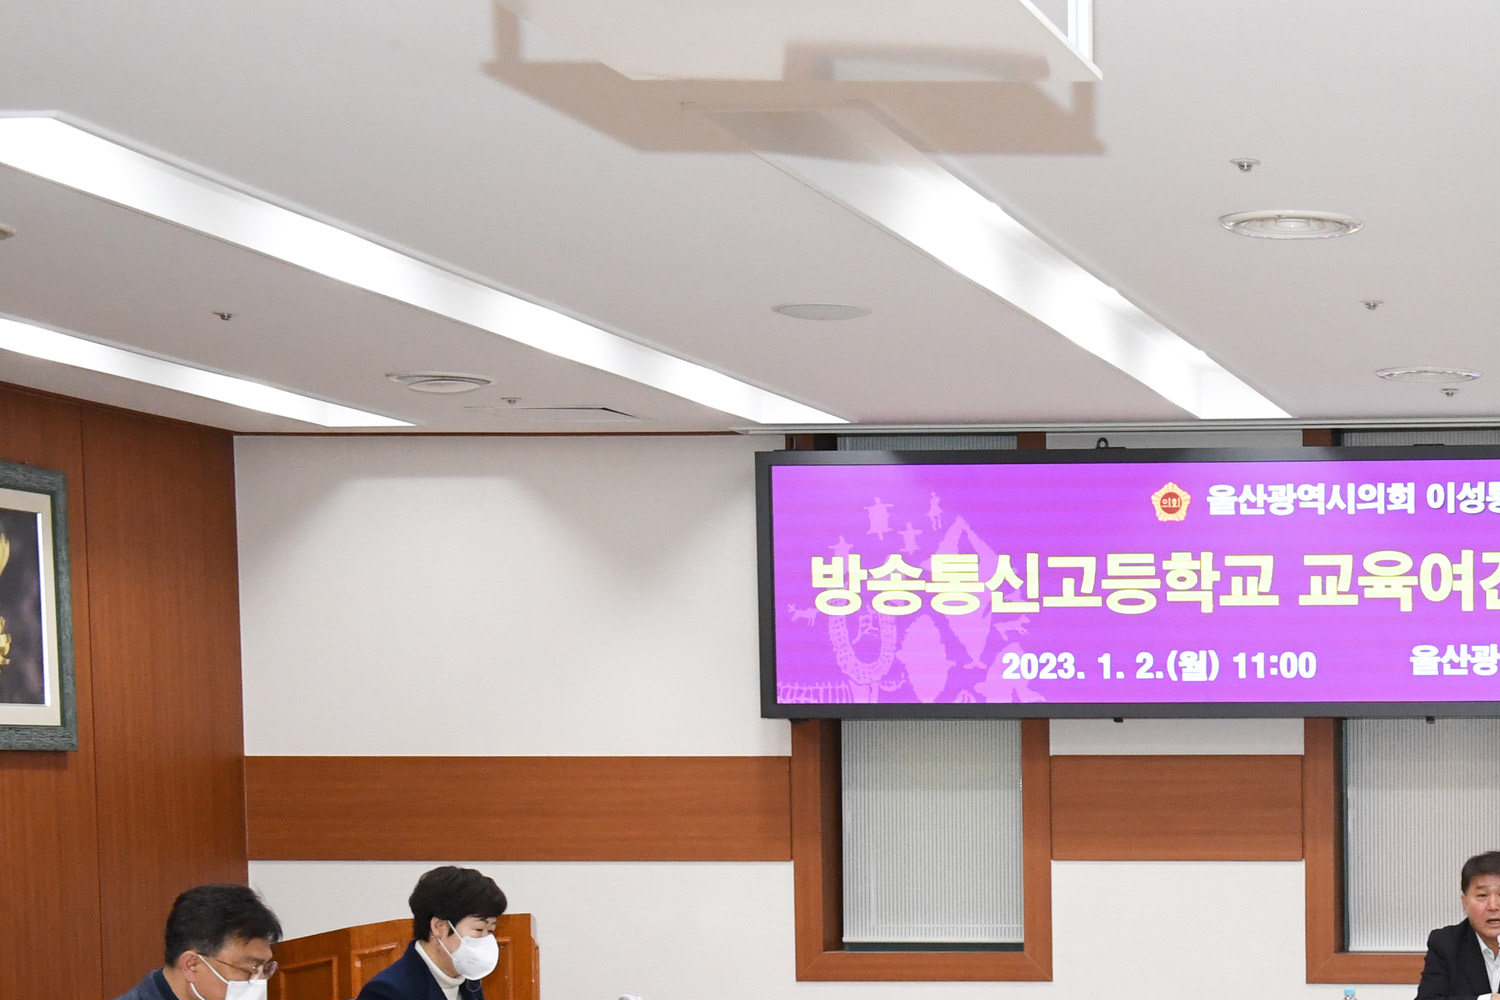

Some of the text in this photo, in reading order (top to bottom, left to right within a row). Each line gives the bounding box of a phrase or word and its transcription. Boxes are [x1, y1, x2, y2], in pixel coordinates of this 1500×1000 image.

[1161, 497, 1180, 508] 의회
[1206, 482, 1415, 516] 울산광역시의회
[811, 551, 1280, 616] 방송통신고등학교
[1002, 649, 1317, 682] 2023. 1. 2.(월) 11:00
